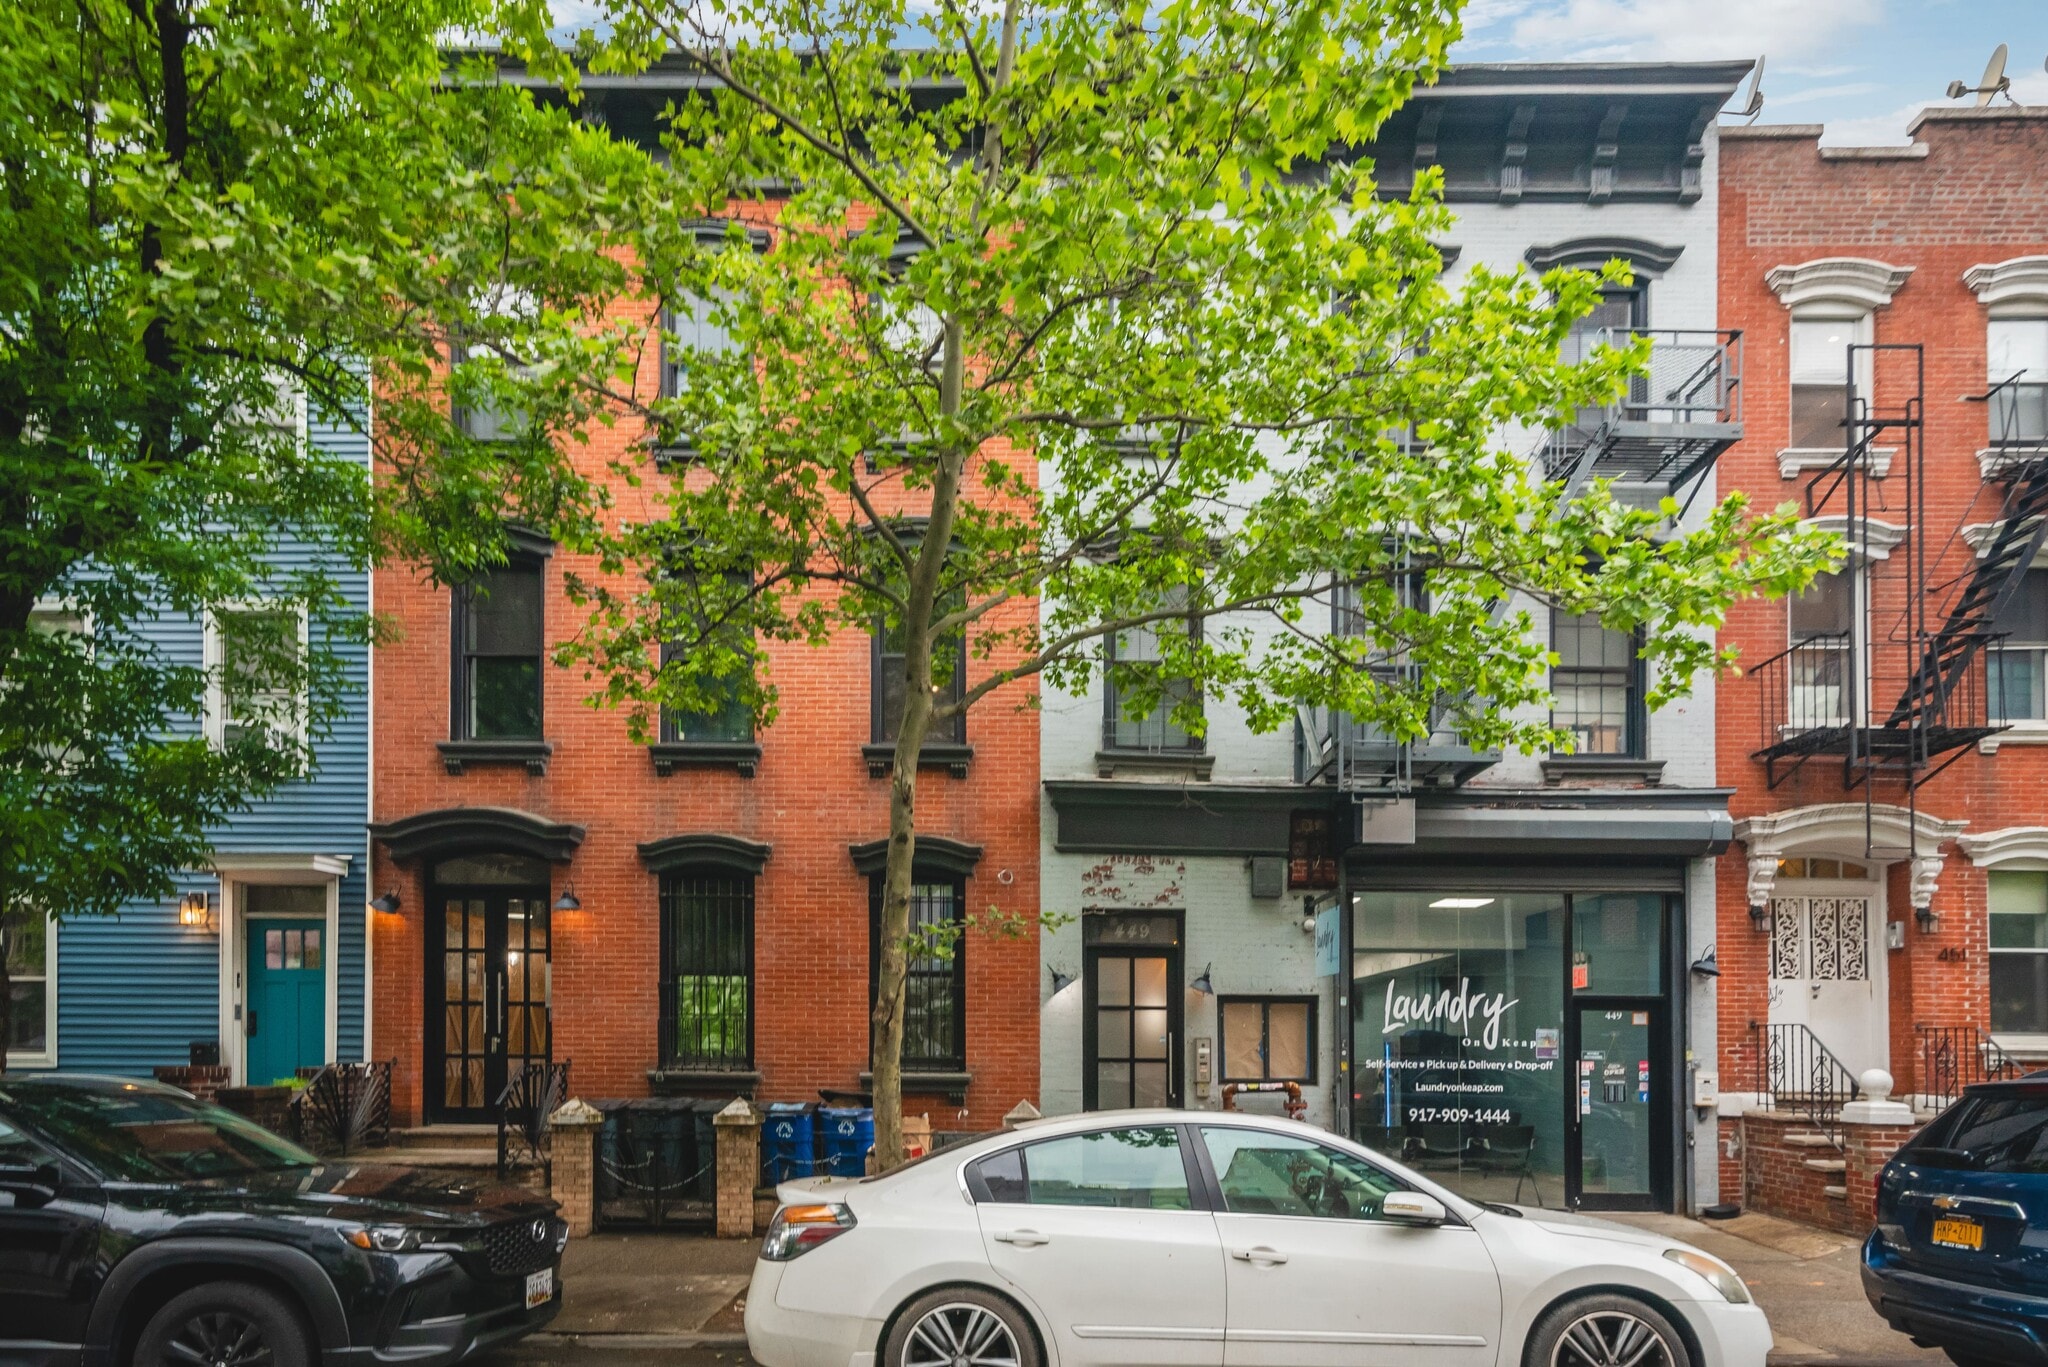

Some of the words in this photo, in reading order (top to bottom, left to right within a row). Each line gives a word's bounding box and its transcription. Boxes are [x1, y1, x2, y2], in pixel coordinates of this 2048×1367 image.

[1114, 923, 1150, 939] 449
[1937, 947, 1966, 963] 451
[1382, 977, 1519, 1050] Laundry
[1604, 1011, 1623, 1020] 449
[1462, 1038, 1480, 1047] On
[1502, 1038, 1537, 1049] Keap
[1365, 1059, 1418, 1069] Self-Service
[1426, 1060, 1446, 1069] Pick
[1447, 1062, 1458, 1071] up
[1459, 1060, 1467, 1069] &
[1468, 1060, 1506, 1071] Delivery
[1514, 1060, 1554, 1072] Drop-off
[1603, 1068, 1625, 1076] OPEN
[1415, 1082, 1504, 1093] Laundryonkeap.com
[1408, 1108, 1511, 1123] 917-909-1444
